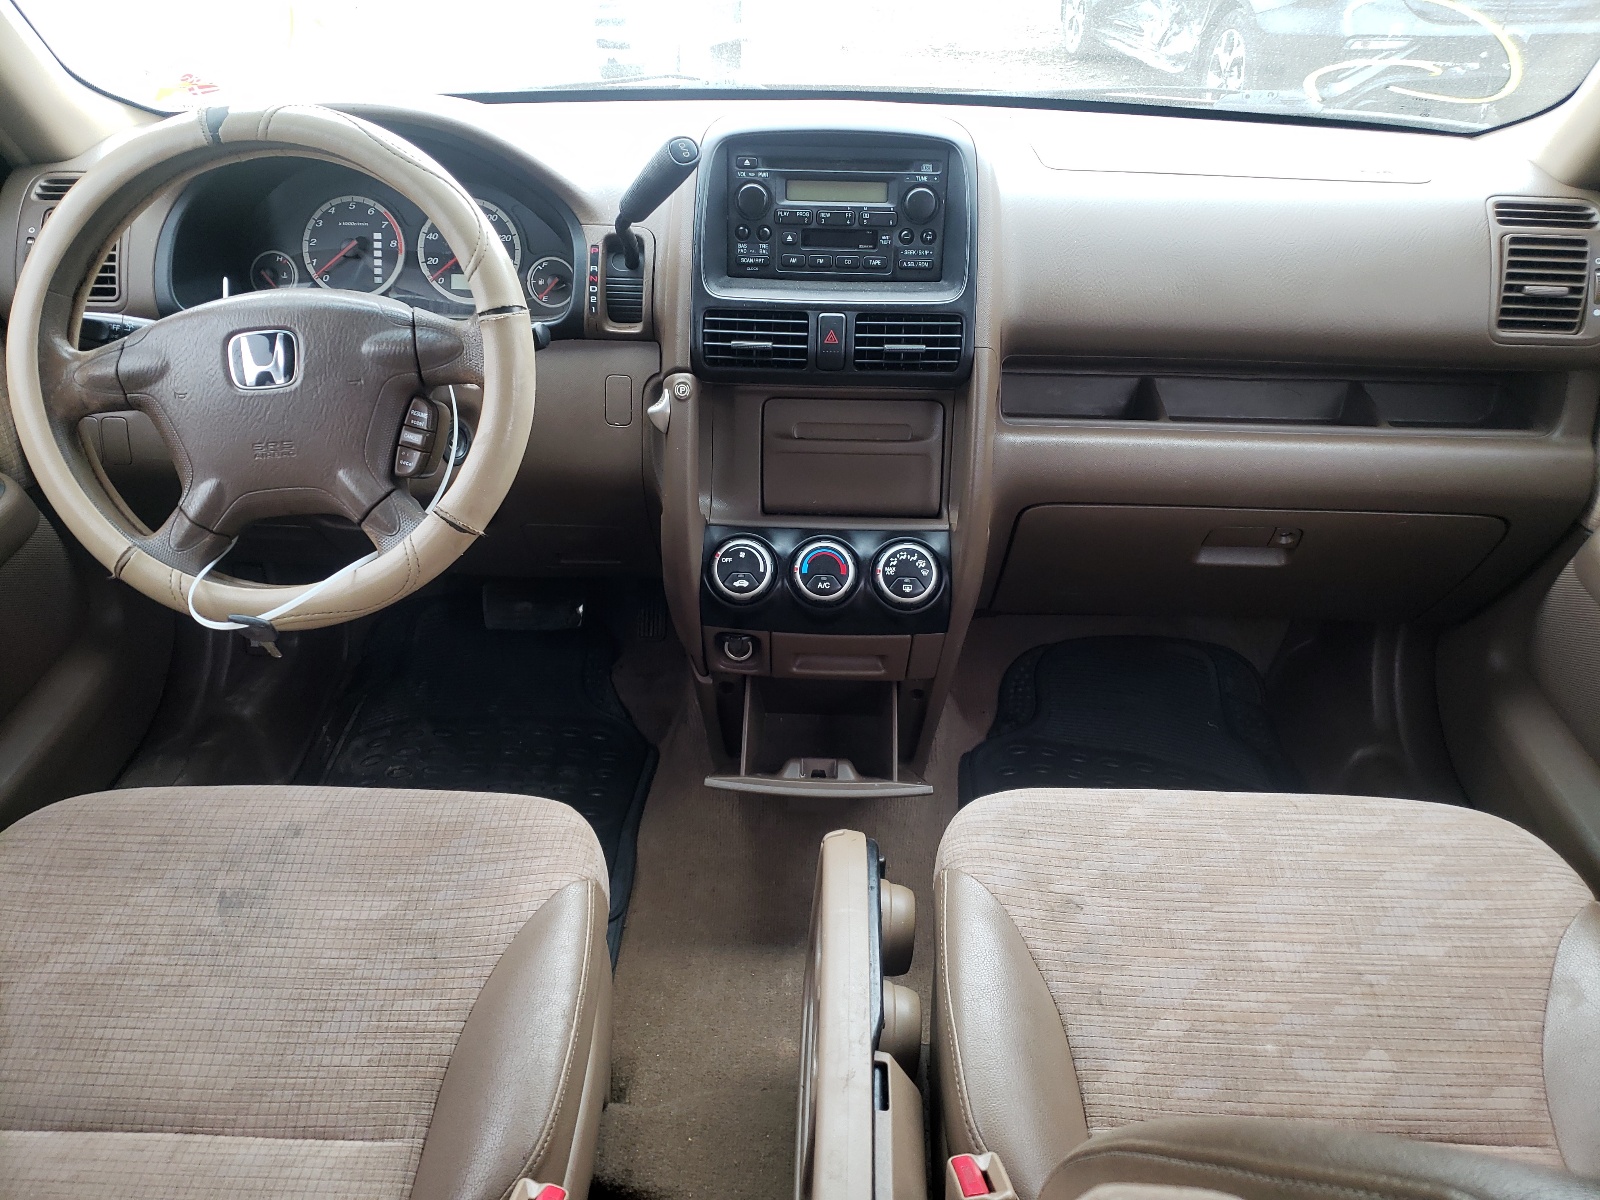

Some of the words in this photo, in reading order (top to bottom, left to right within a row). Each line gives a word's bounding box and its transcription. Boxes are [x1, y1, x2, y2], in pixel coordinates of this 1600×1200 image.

[348, 202, 356, 210] 5
[367, 207, 375, 216] 6
[315, 220, 323, 228] 3
[390, 240, 398, 248] 8
[426, 257, 439, 265] 20
